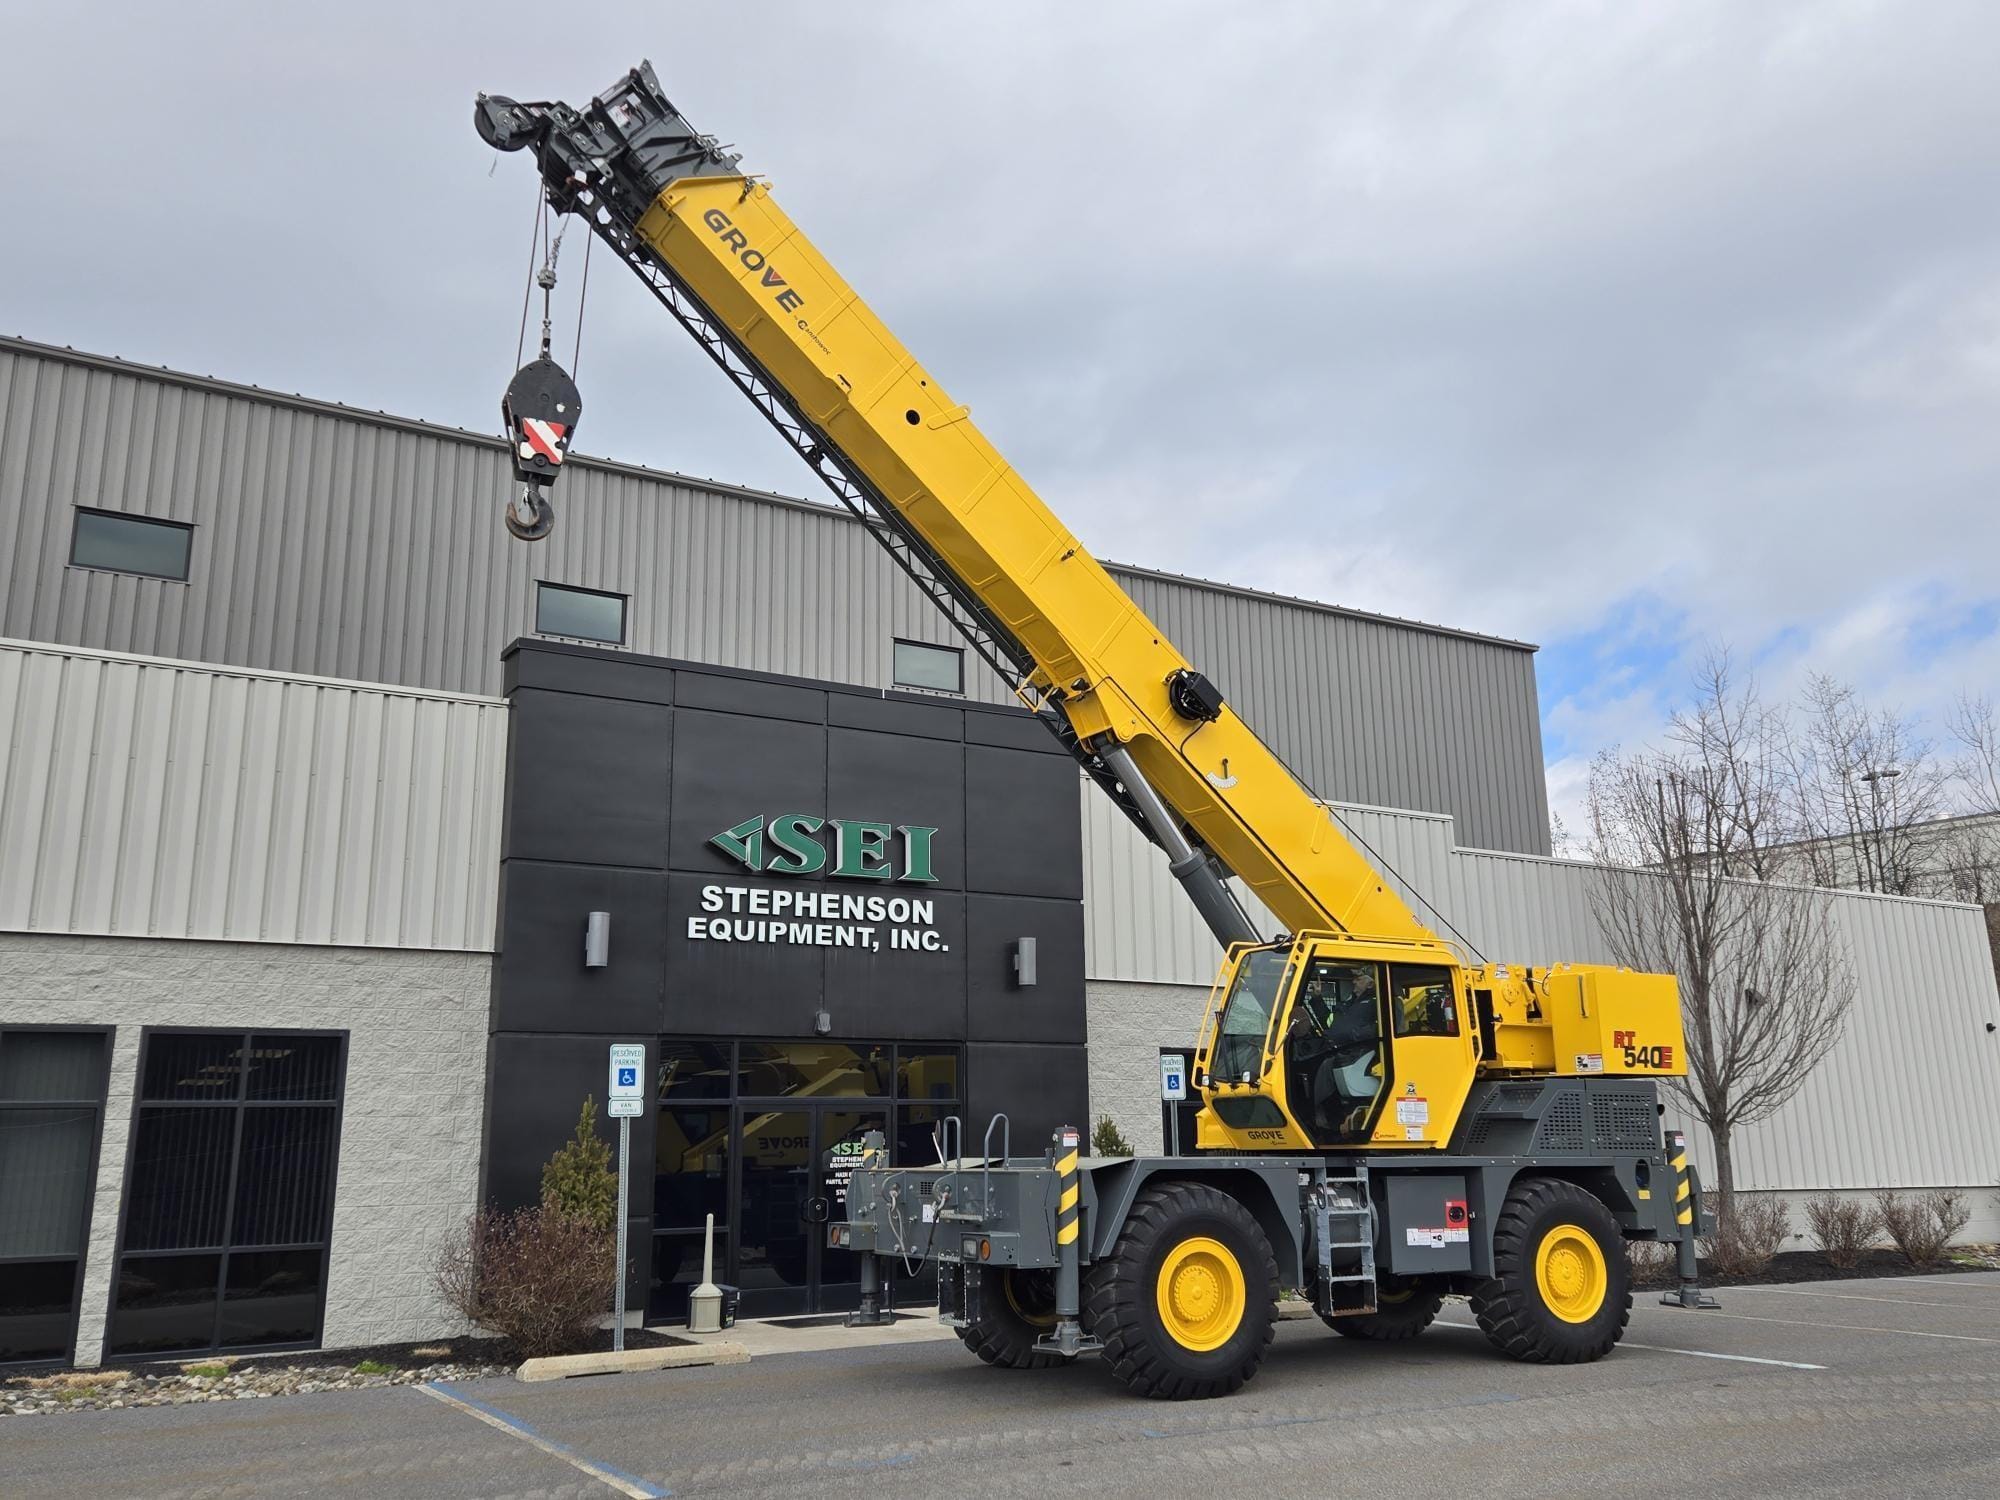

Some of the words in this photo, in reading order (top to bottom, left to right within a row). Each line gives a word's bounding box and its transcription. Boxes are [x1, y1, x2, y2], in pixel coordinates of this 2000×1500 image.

[704, 209, 804, 313] GROVE
[767, 814, 939, 881] SEI
[701, 885, 934, 925] STEPHENSON
[687, 917, 879, 952] EQUIPMENT,
[890, 928, 949, 951] INC.
[1613, 1031, 1636, 1049] RT
[613, 1049, 641, 1057] RESERVED
[1624, 1046, 1672, 1068] 540E
[1248, 1130, 1284, 1140] GROVE
[841, 1142, 864, 1155] SE
